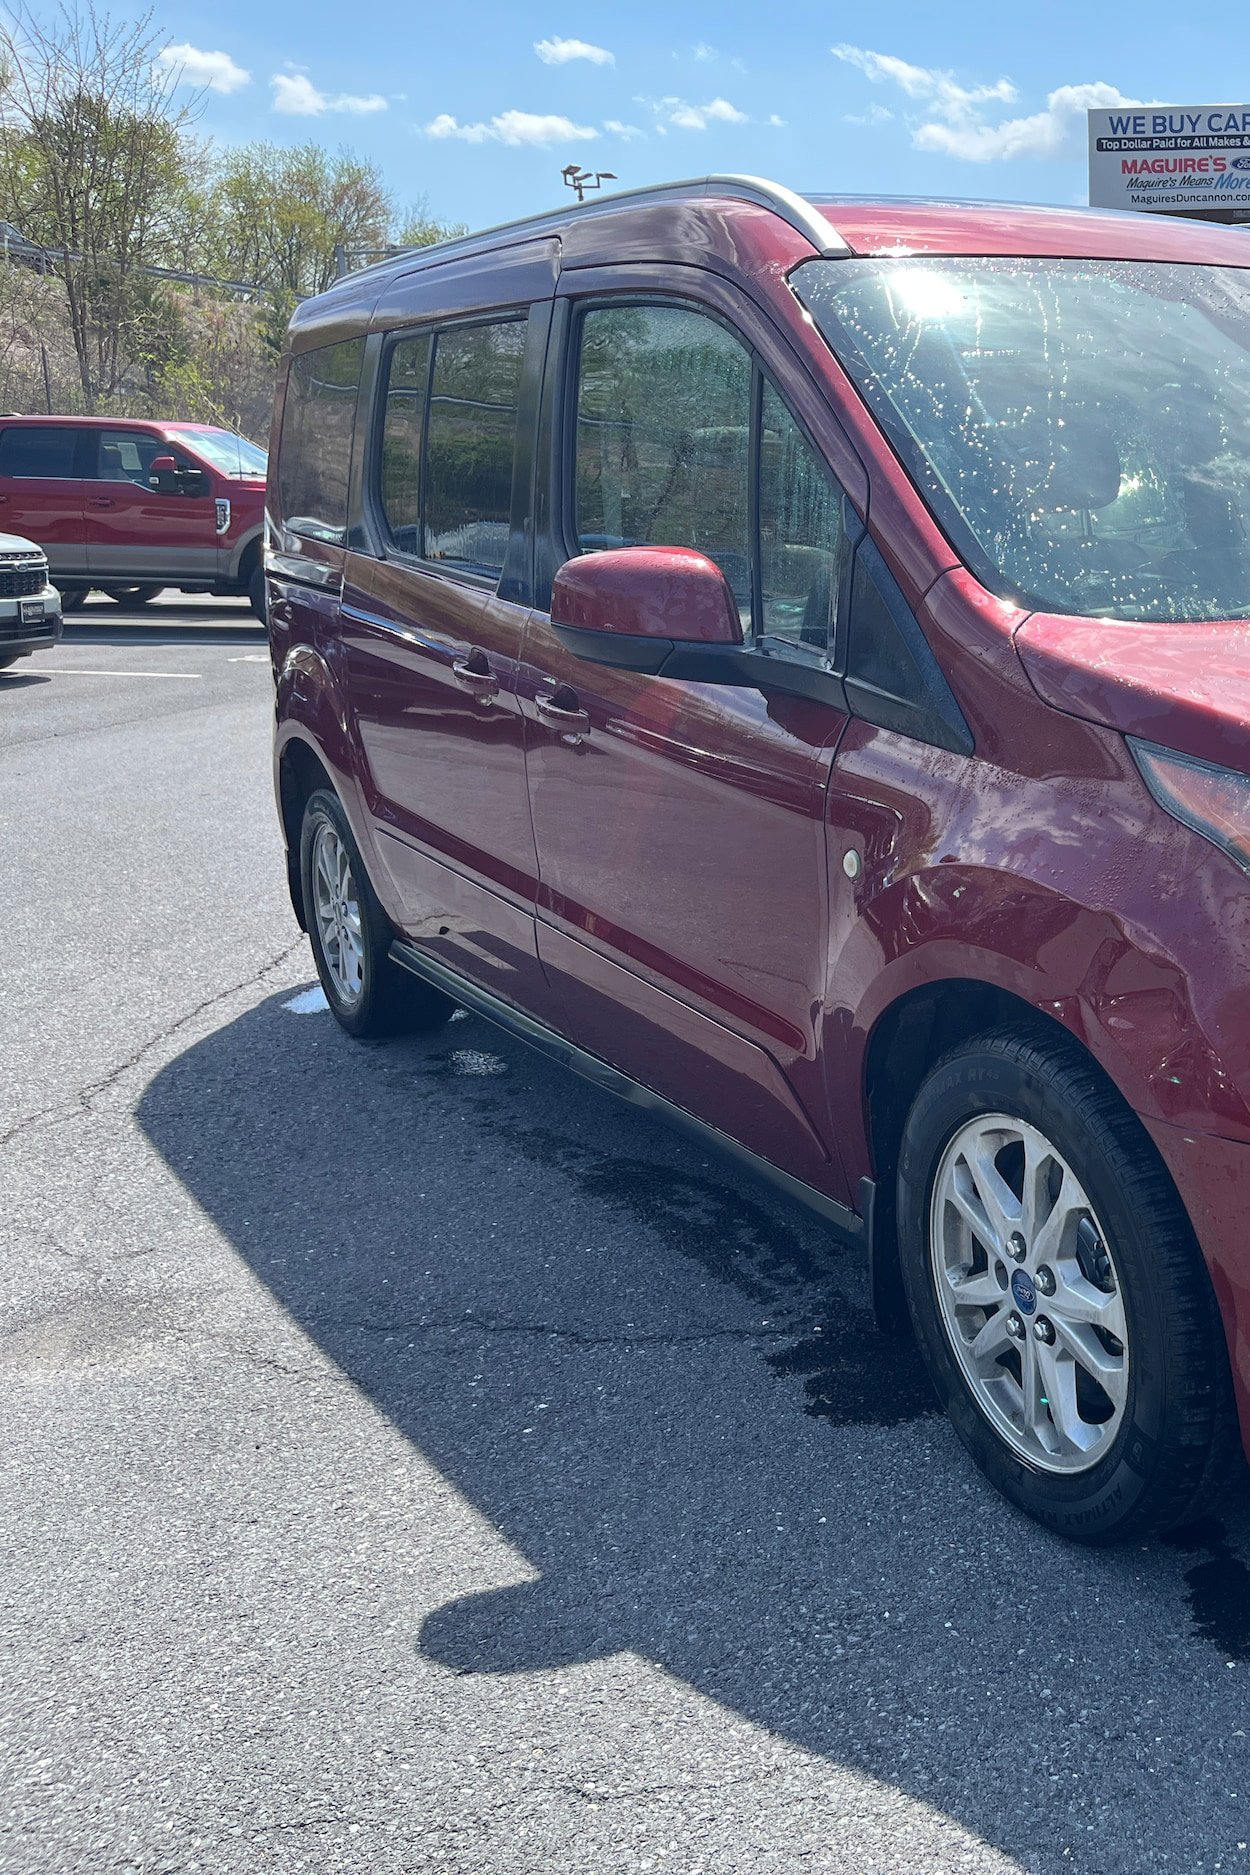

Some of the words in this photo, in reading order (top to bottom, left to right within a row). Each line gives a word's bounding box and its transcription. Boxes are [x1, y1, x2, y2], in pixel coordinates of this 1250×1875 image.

[1108, 115, 1146, 135] WE
[1152, 113, 1202, 134] BUY
[1101, 139, 1119, 150] Top
[1121, 139, 1151, 149] Dollar
[1153, 138, 1175, 148] Paid
[1177, 137, 1191, 147] for
[1192, 137, 1206, 147] All
[1208, 136, 1240, 147] Makes
[1242, 136, 1250, 146] &
[1121, 155, 1227, 174] MAGUIRE'S
[1126, 177, 1177, 191] Maguire's
[1179, 174, 1214, 187] Means
